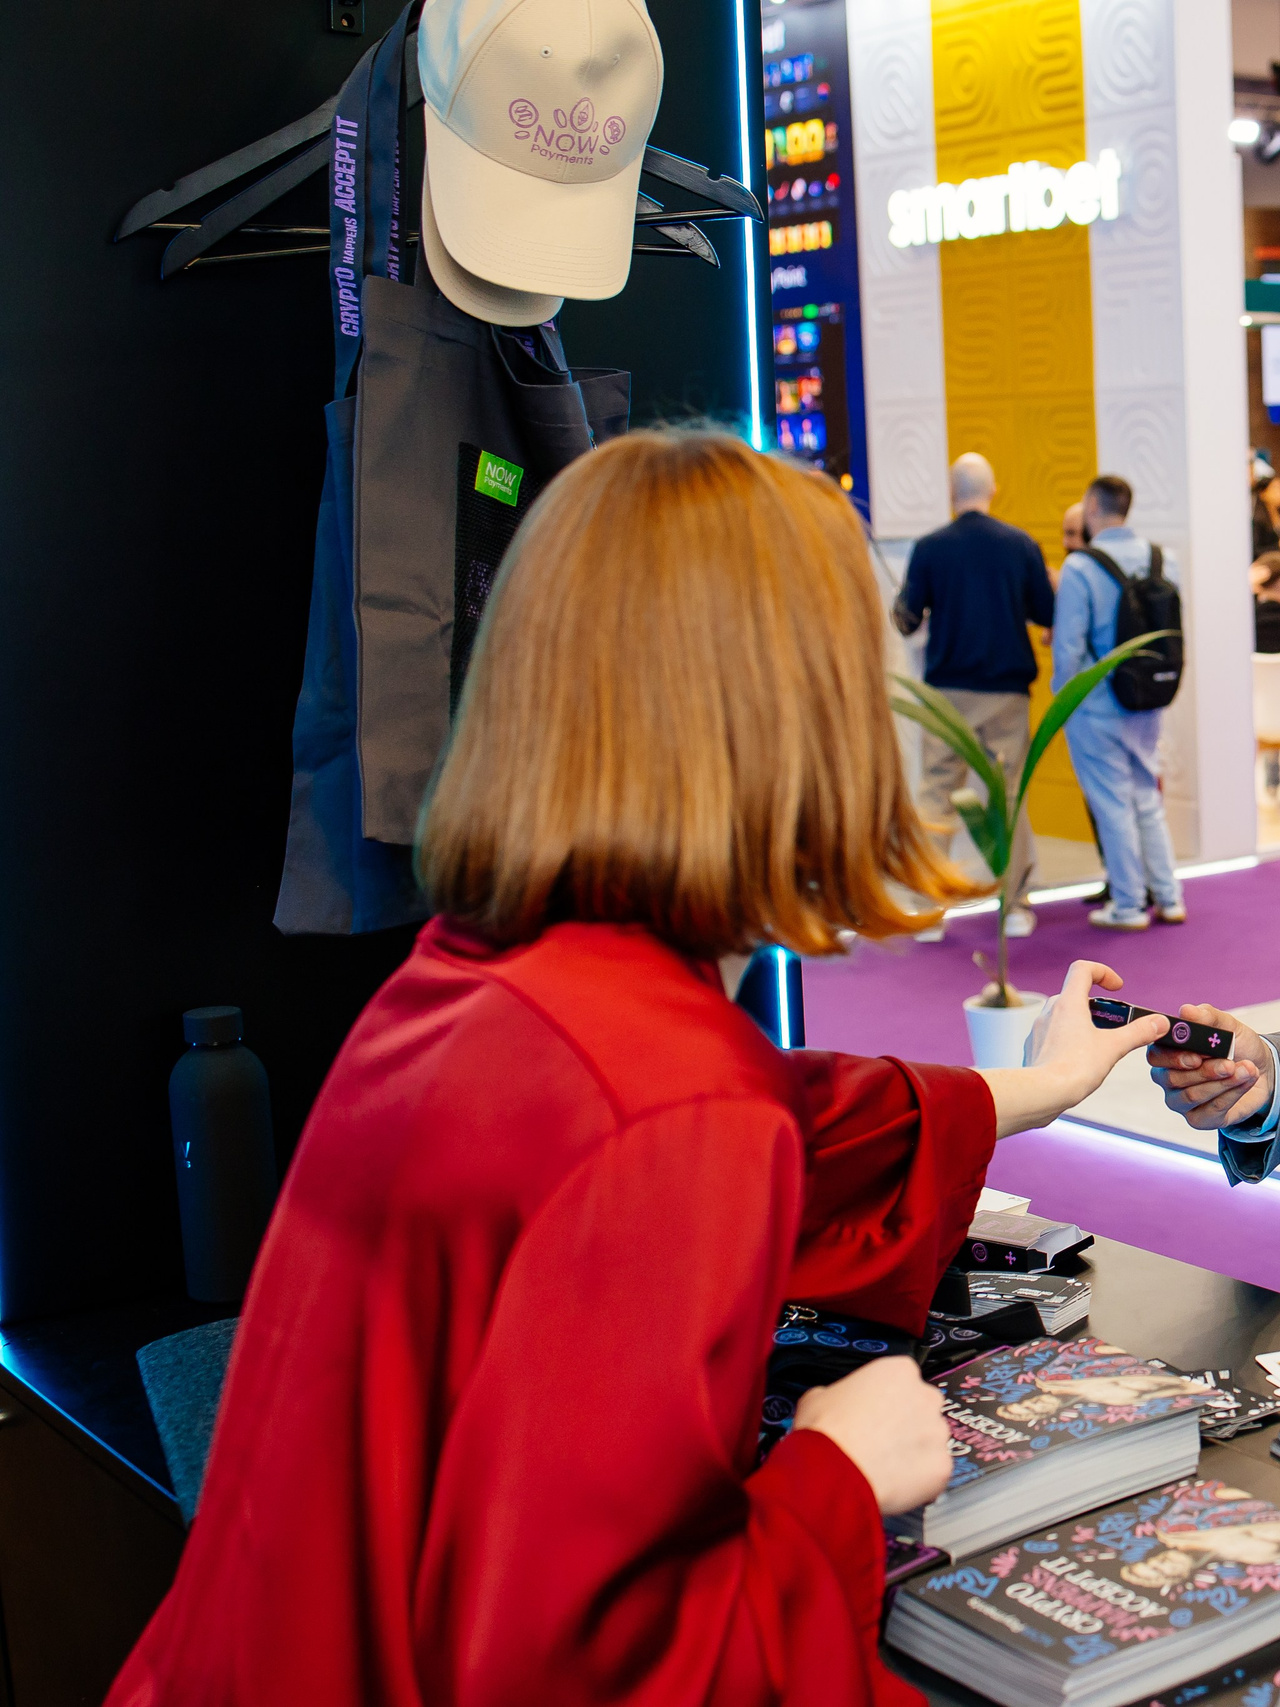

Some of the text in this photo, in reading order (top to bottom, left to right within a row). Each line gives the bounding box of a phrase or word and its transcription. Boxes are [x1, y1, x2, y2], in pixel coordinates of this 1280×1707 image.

[533, 124, 600, 155] NOW
[530, 143, 595, 165] Payments
[334, 115, 360, 338] CRYPTO HAPPENS ACCEPT IT
[483, 475, 513, 496] Payments
[485, 461, 517, 488] NOW
